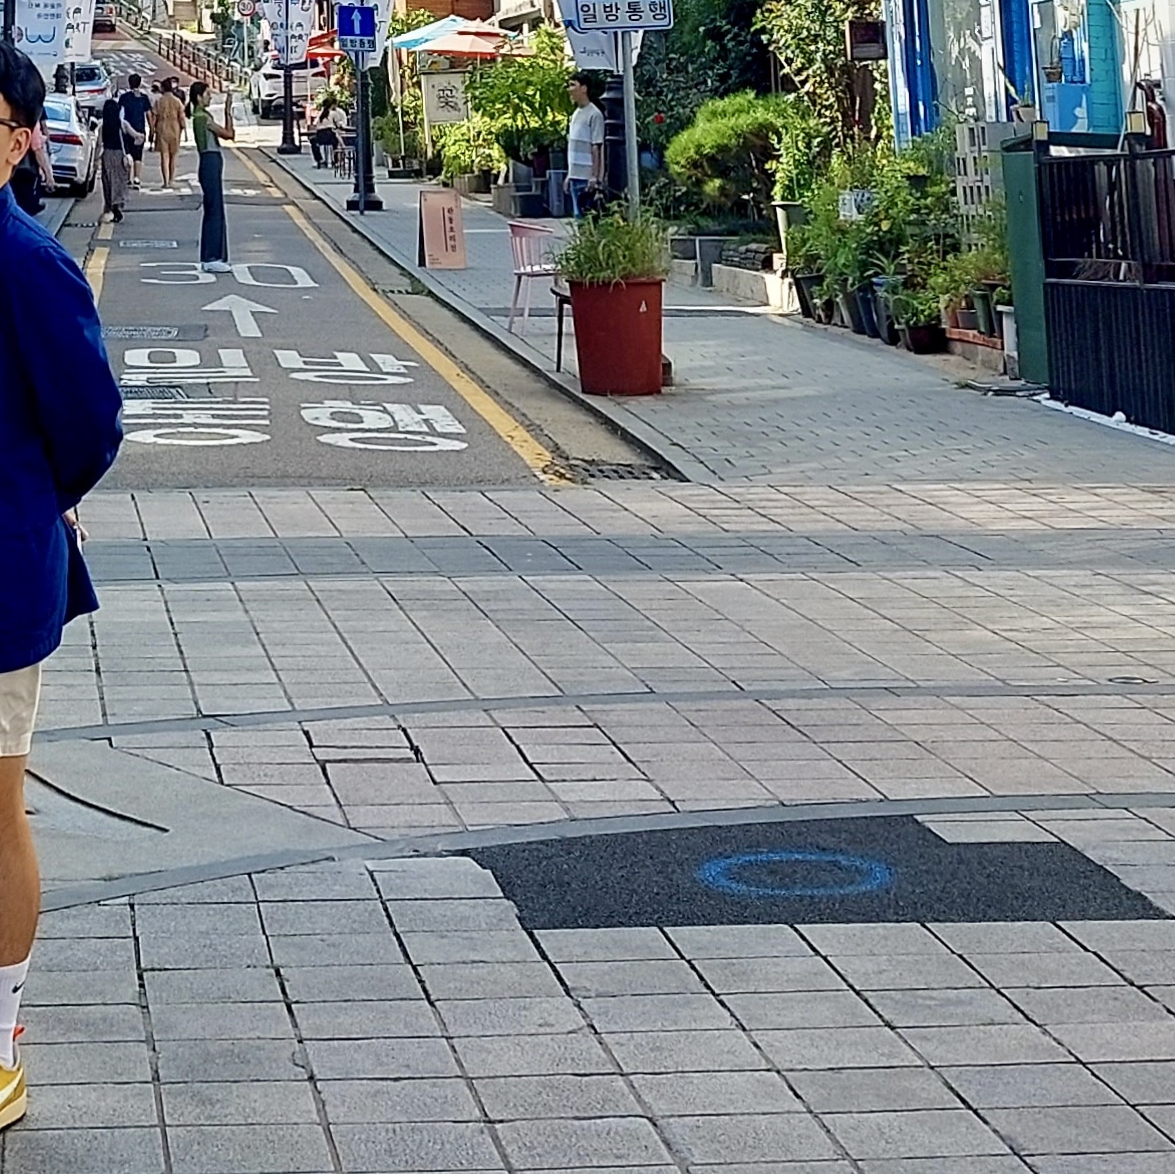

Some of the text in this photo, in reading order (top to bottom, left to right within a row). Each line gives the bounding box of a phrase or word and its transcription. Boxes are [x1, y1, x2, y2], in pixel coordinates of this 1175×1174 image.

[580, 0, 668, 23] 일방통행
[139, 261, 320, 289] 30
[120, 347, 421, 385] 일방
[121, 397, 469, 452] 통행
